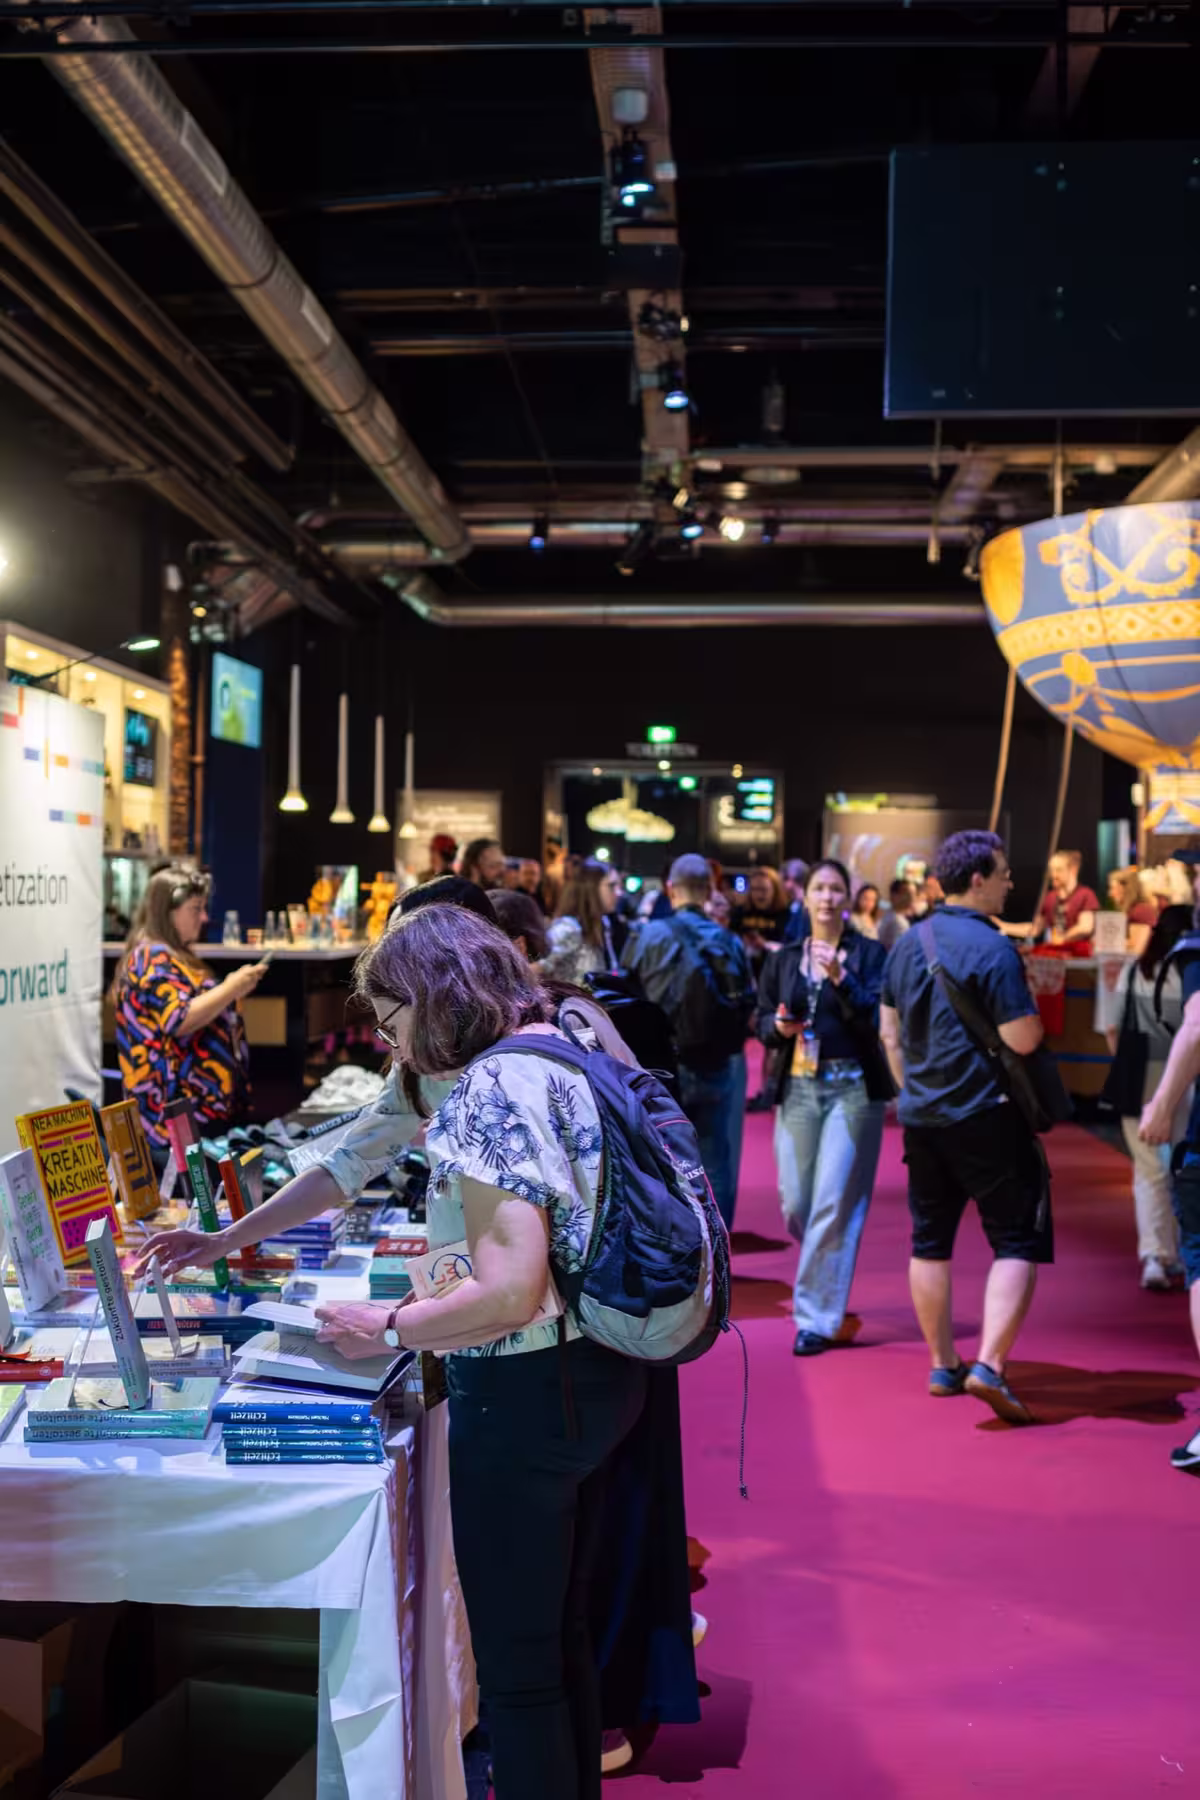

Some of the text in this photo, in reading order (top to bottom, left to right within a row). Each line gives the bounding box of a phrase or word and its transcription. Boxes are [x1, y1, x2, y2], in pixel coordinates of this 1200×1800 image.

[0, 861, 68, 907] tization
[32, 1105, 90, 1131] NEA MACHINA
[40, 1143, 99, 1177] KREATIV
[48, 1165, 107, 1199] MASCHINE
[94, 1247, 111, 1294] gestalten
